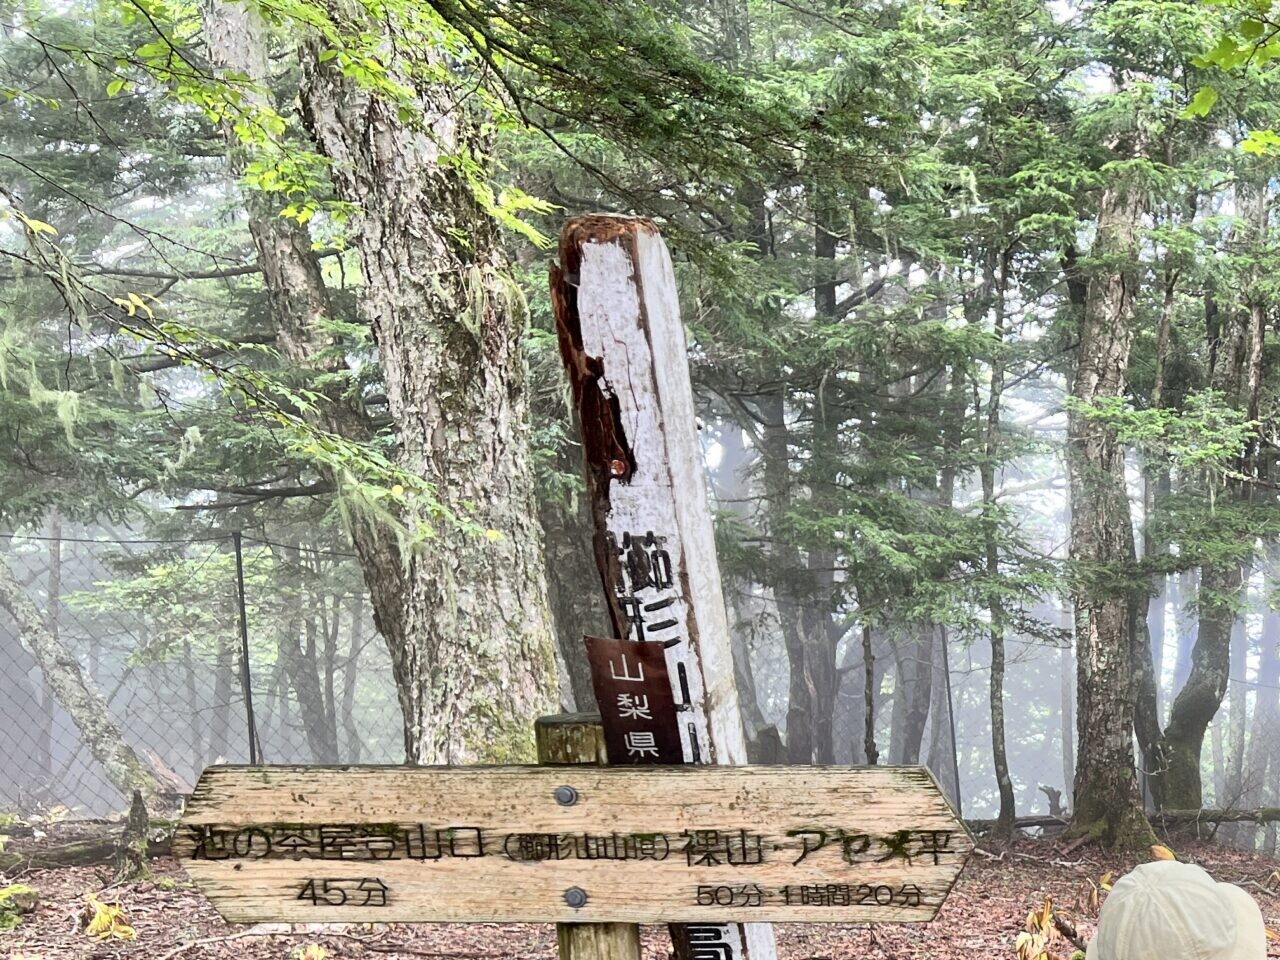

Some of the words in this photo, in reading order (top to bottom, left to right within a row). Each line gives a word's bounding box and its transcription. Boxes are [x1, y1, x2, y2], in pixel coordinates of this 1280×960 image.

[609, 653, 659, 757] 山梨県
[190, 823, 484, 860] 池の茶屋登山口
[297, 877, 388, 906] 45分
